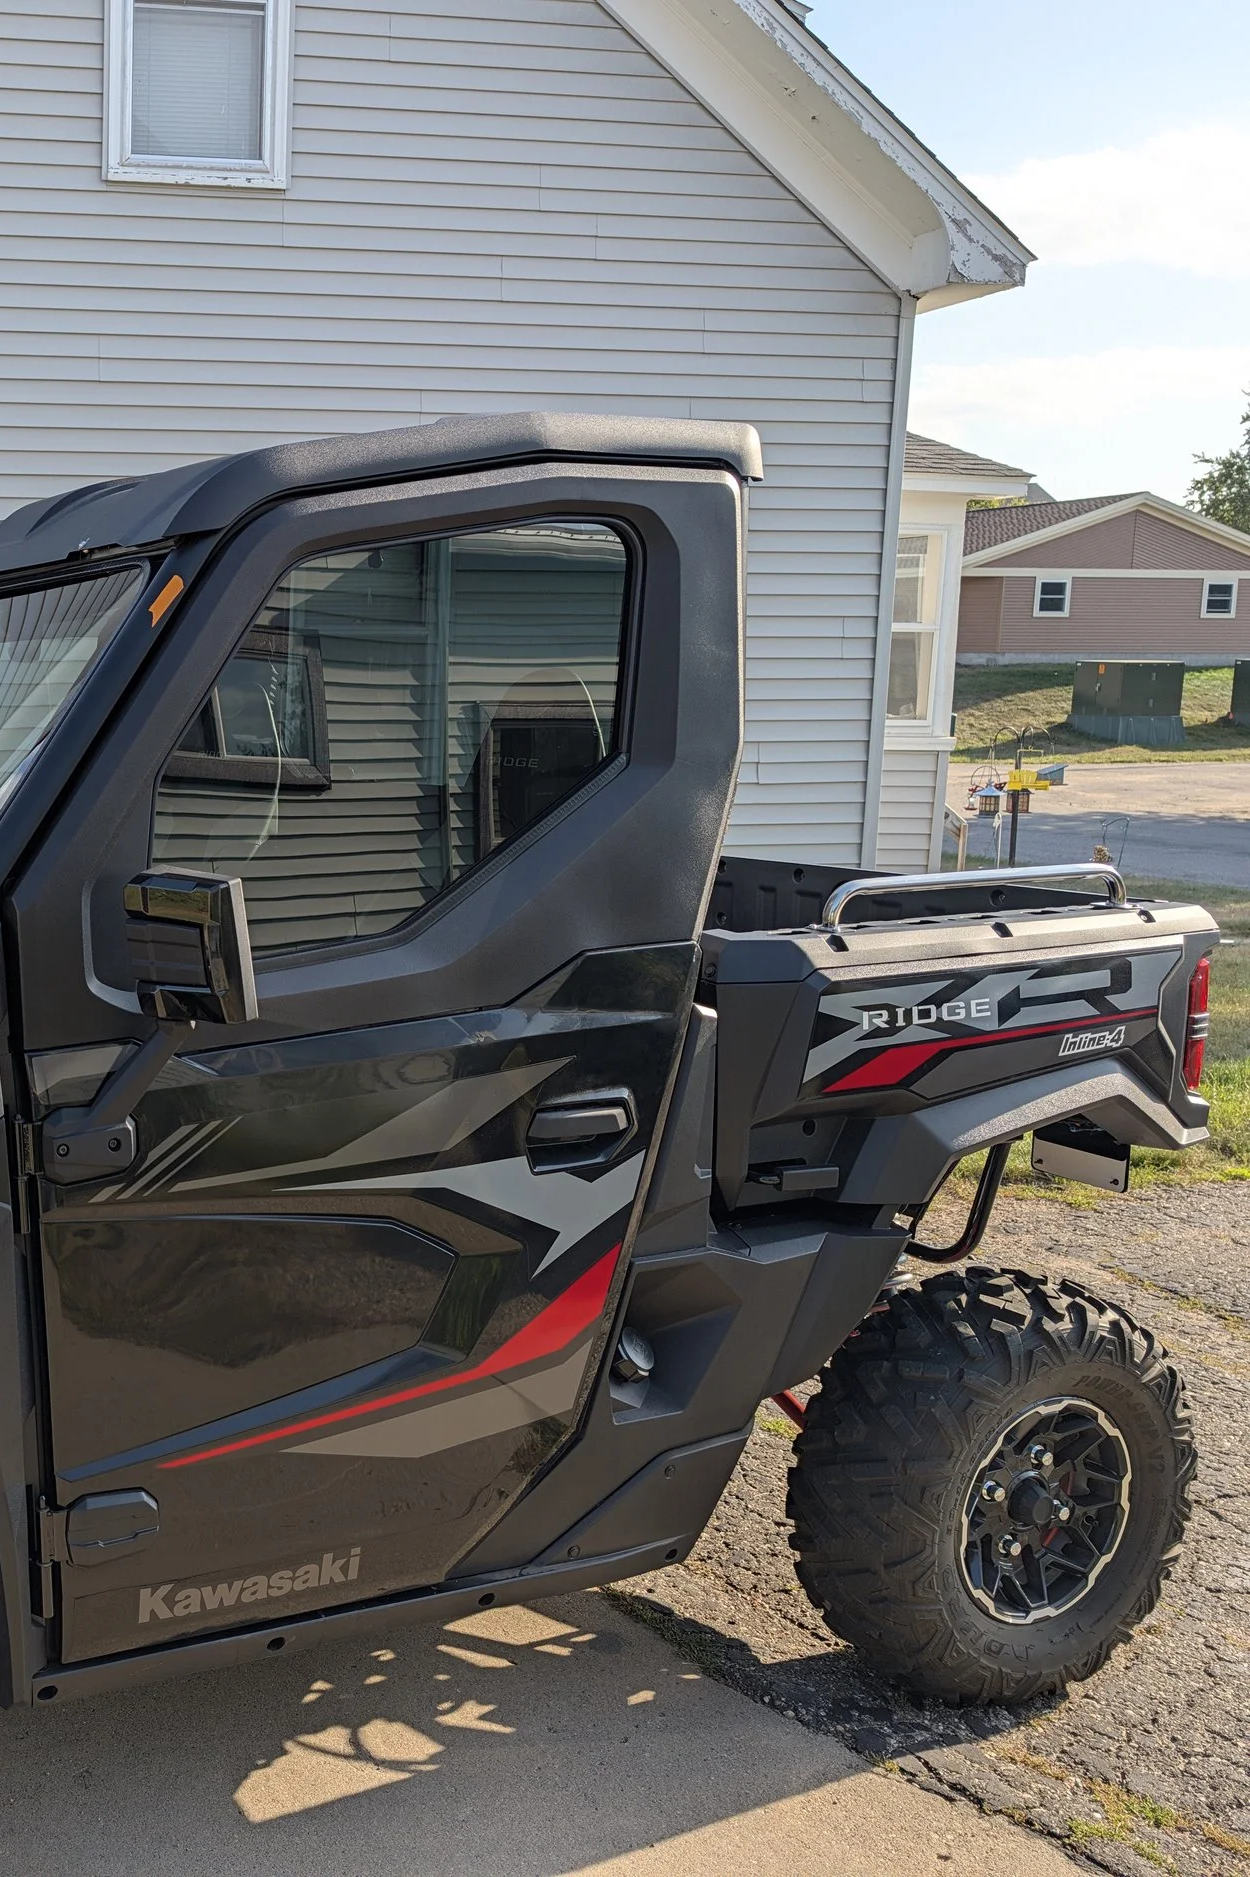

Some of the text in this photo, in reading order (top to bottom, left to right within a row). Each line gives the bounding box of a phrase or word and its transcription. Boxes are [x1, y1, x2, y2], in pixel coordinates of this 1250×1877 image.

[486, 756, 539, 768] RIDGE
[862, 998, 992, 1030] RIDGE
[1058, 1025, 1126, 1056] Inline-4
[138, 1547, 361, 1624] Kawasaki
